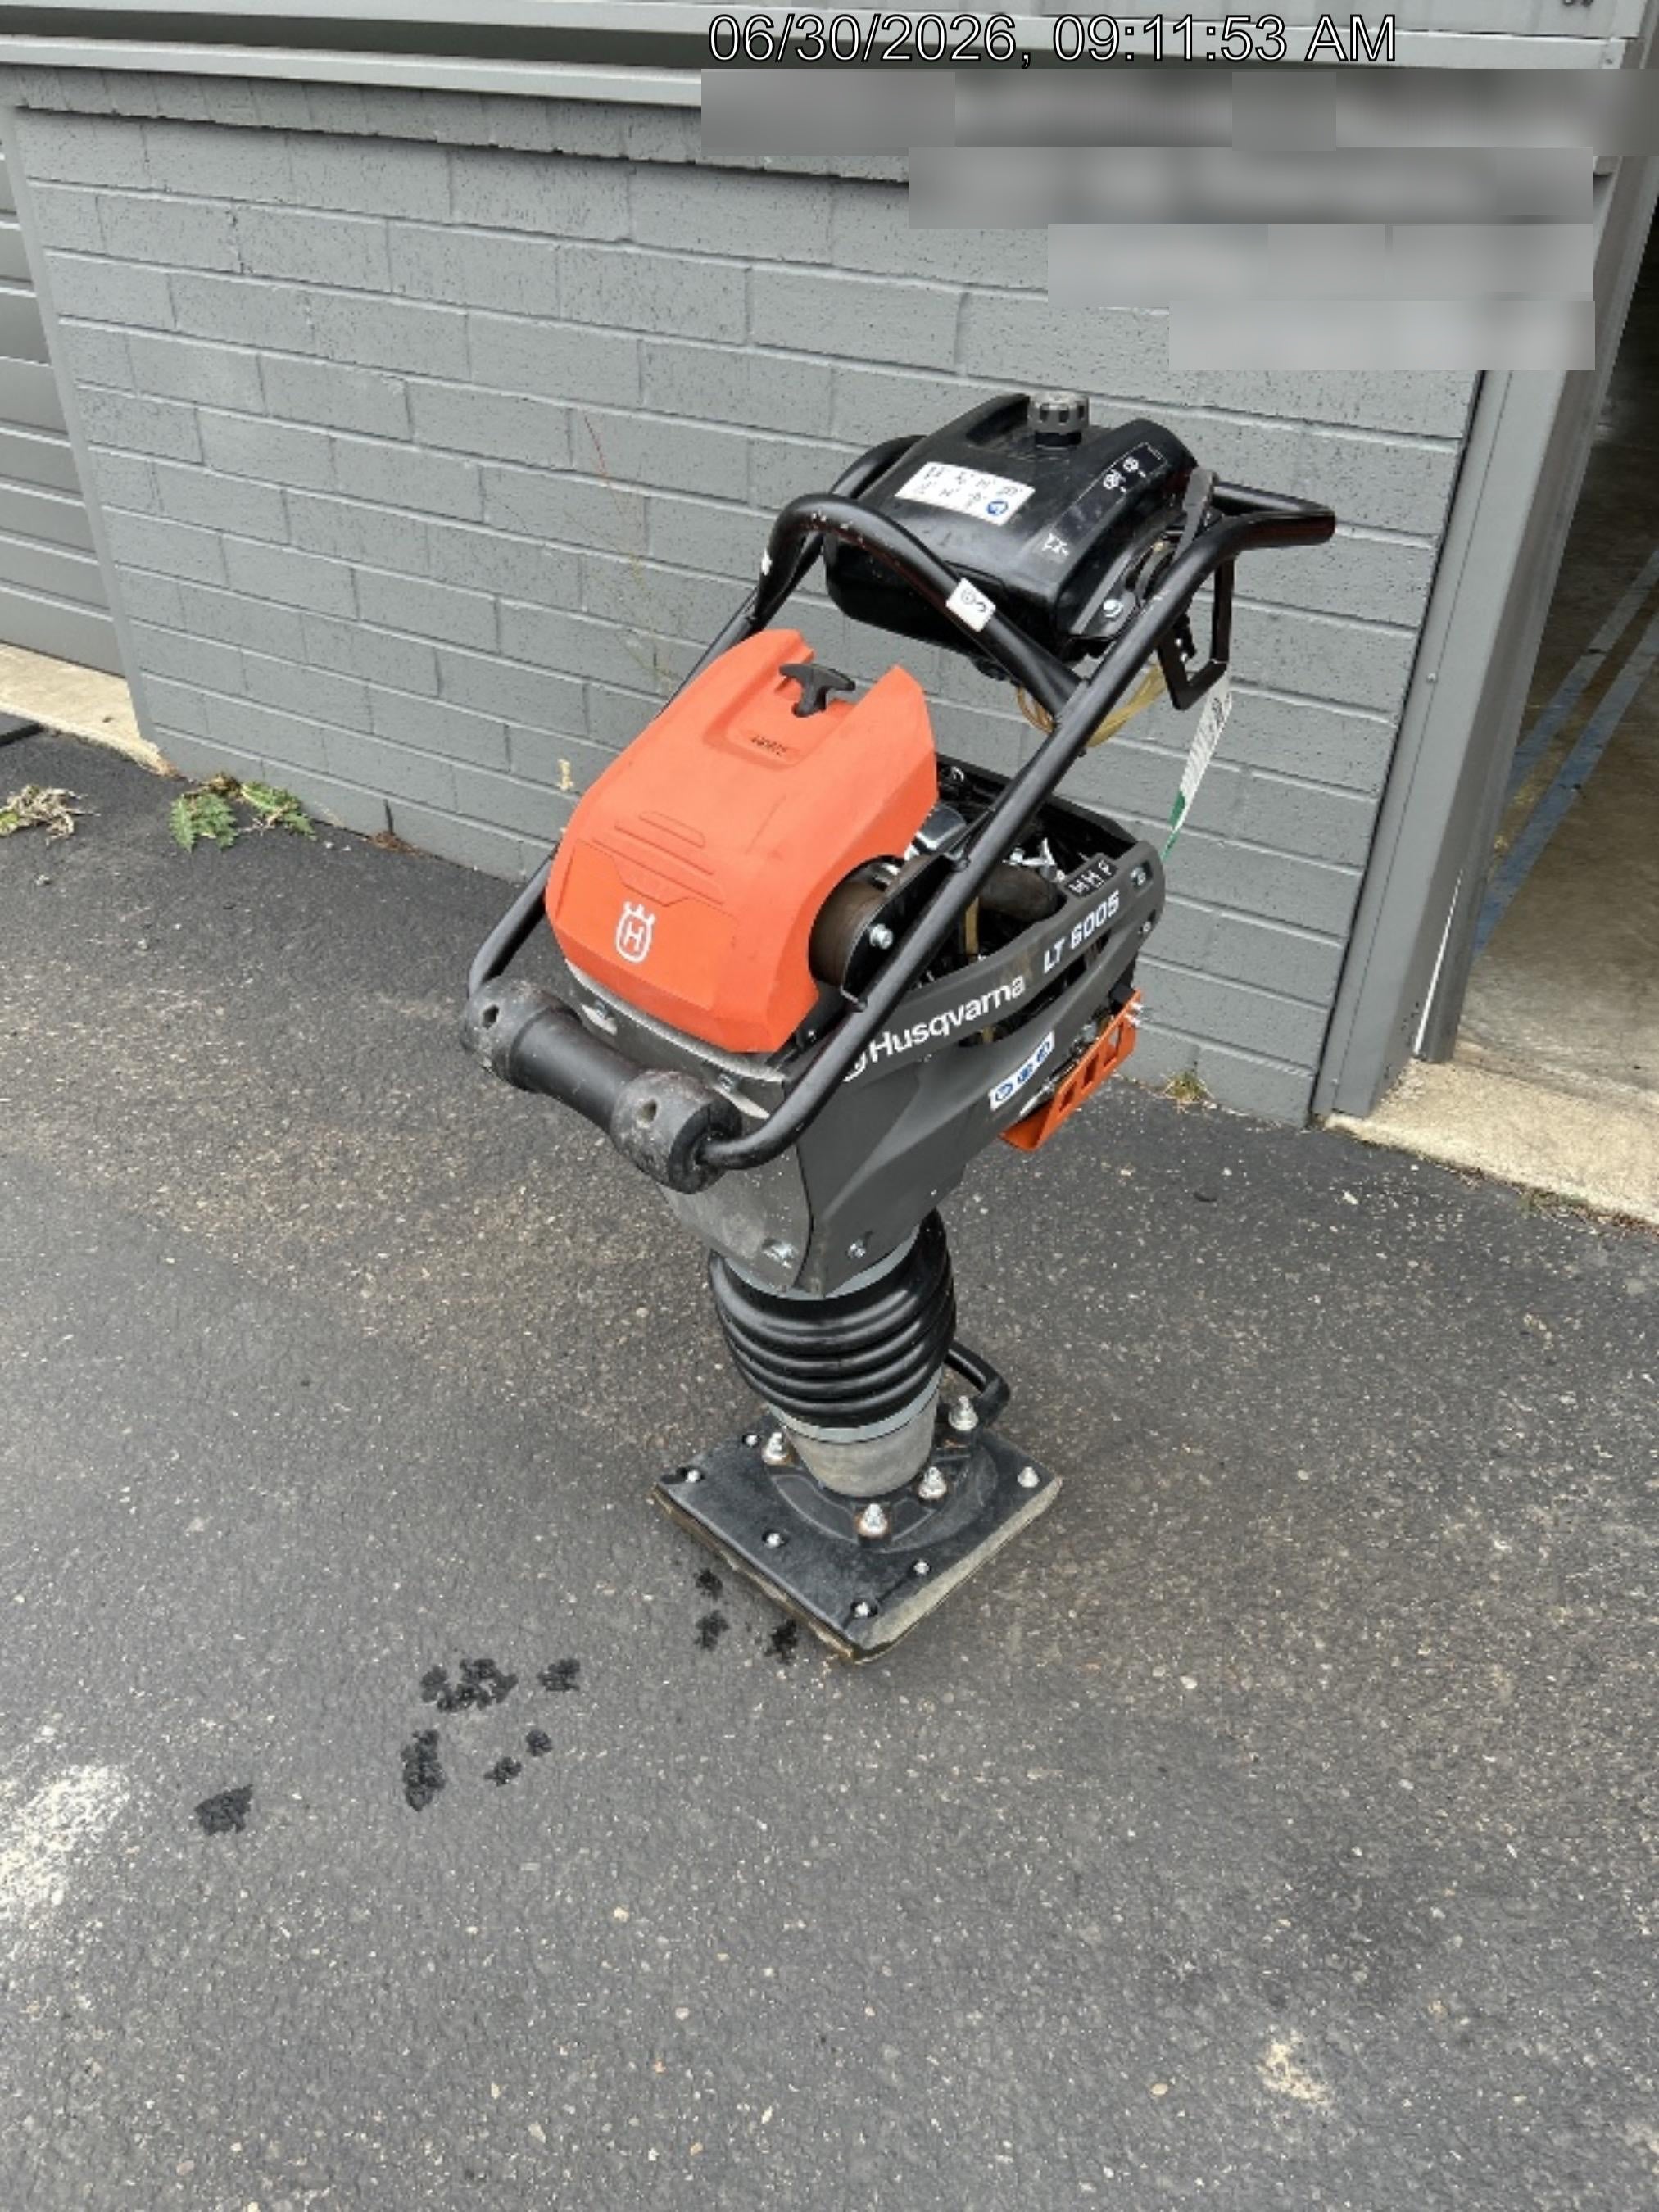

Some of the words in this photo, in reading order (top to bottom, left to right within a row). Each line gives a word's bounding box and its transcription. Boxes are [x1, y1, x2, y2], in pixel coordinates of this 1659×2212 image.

[1044, 938, 1065, 973] LT
[1071, 889, 1120, 950] 6005
[869, 975, 1026, 1063] Husqvarna
